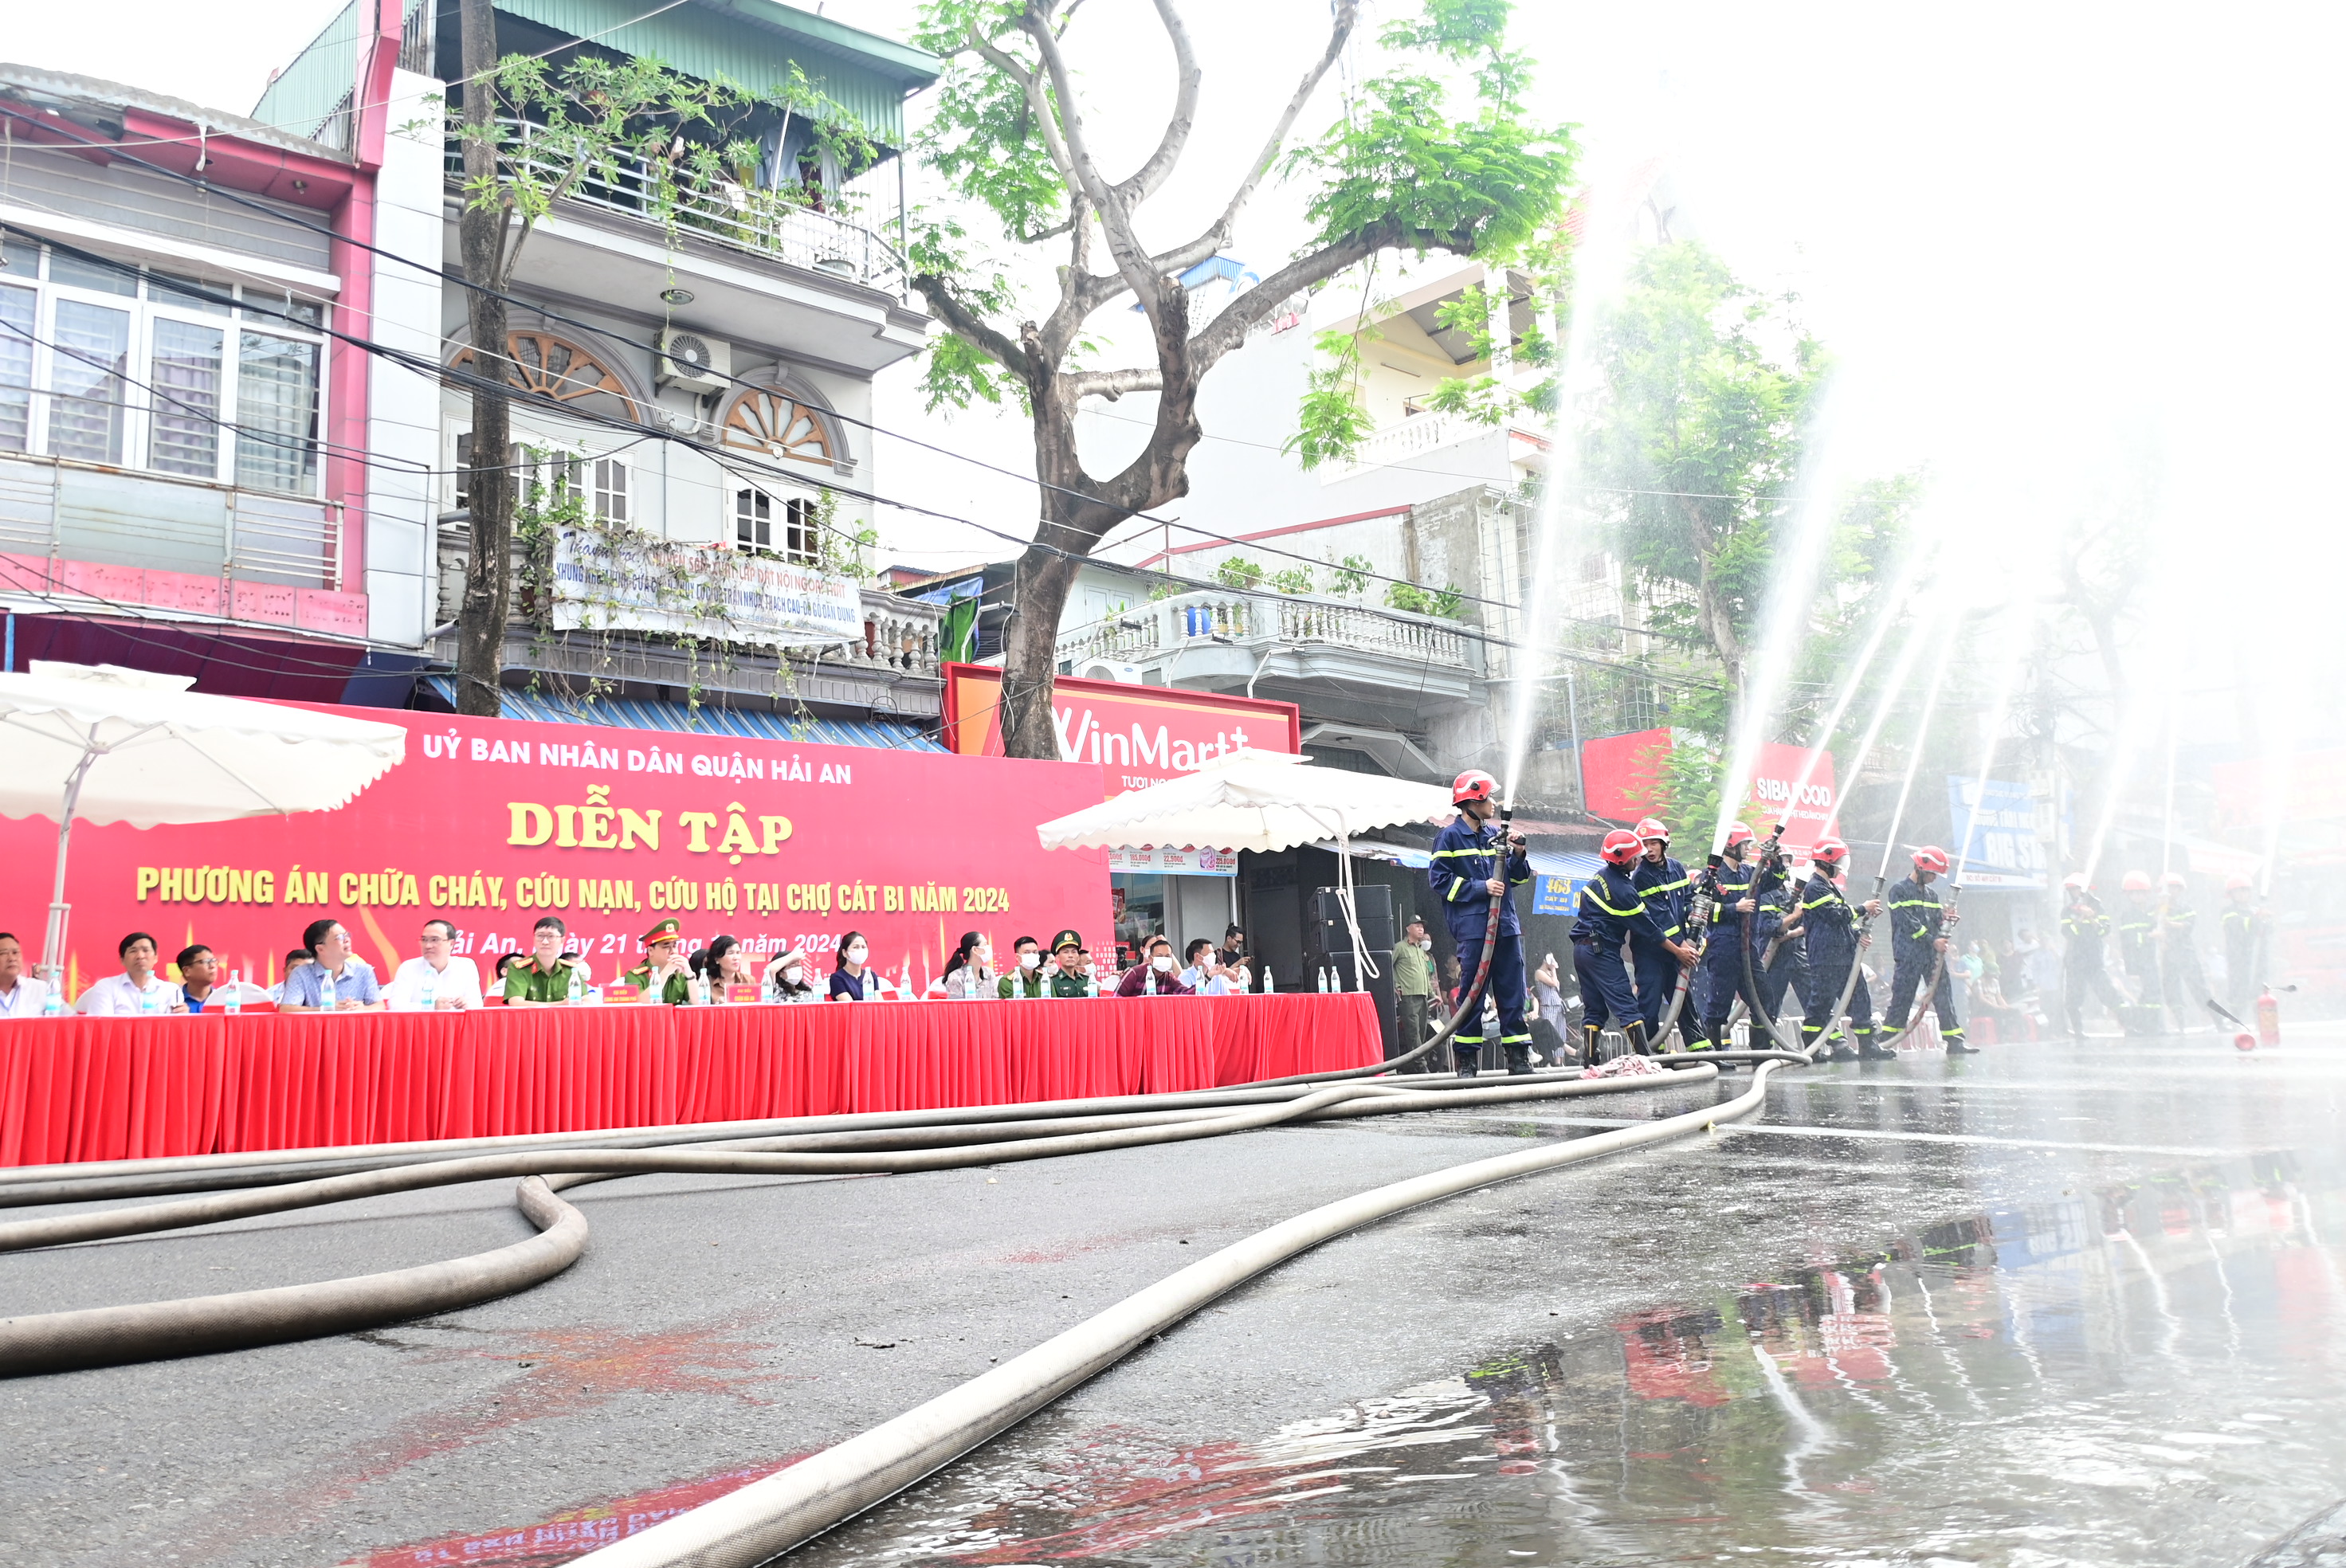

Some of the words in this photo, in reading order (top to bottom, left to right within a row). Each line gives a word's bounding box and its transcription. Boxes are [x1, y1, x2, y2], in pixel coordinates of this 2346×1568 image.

[556, 563, 584, 583] KHUNG
[423, 728, 461, 759] UỶ
[471, 738, 530, 764] BAN
[539, 740, 618, 770] NHÂN
[627, 746, 683, 774] DÂN
[691, 751, 763, 784] QUẬN
[771, 754, 811, 782] HẢI
[819, 763, 852, 785] AN
[1121, 775, 1148, 789] TƯƠI
[507, 783, 662, 851] DIỄN
[679, 802, 793, 865] TẬP
[1986, 832, 2017, 868] BIG
[137, 865, 274, 905] PHƯƠNG
[284, 864, 328, 904] ÁN
[339, 868, 420, 906] CHỮA
[429, 870, 508, 911] CHÁY,
[516, 872, 571, 908] CỨU
[578, 879, 641, 915] NẠN,
[649, 876, 699, 910] CỨU
[705, 876, 738, 916] HỘ
[743, 883, 780, 916] TẠI
[787, 881, 832, 917] CHỢ
[837, 880, 877, 912] CÁT
[884, 885, 904, 911] BI
[911, 881, 958, 912] NĂM
[963, 887, 1010, 913] 2024
[1547, 876, 1572, 895] 463
[452, 930, 474, 954] ải
[600, 933, 627, 954] 21
[741, 933, 787, 953] năm
[794, 934, 842, 953] 2024
